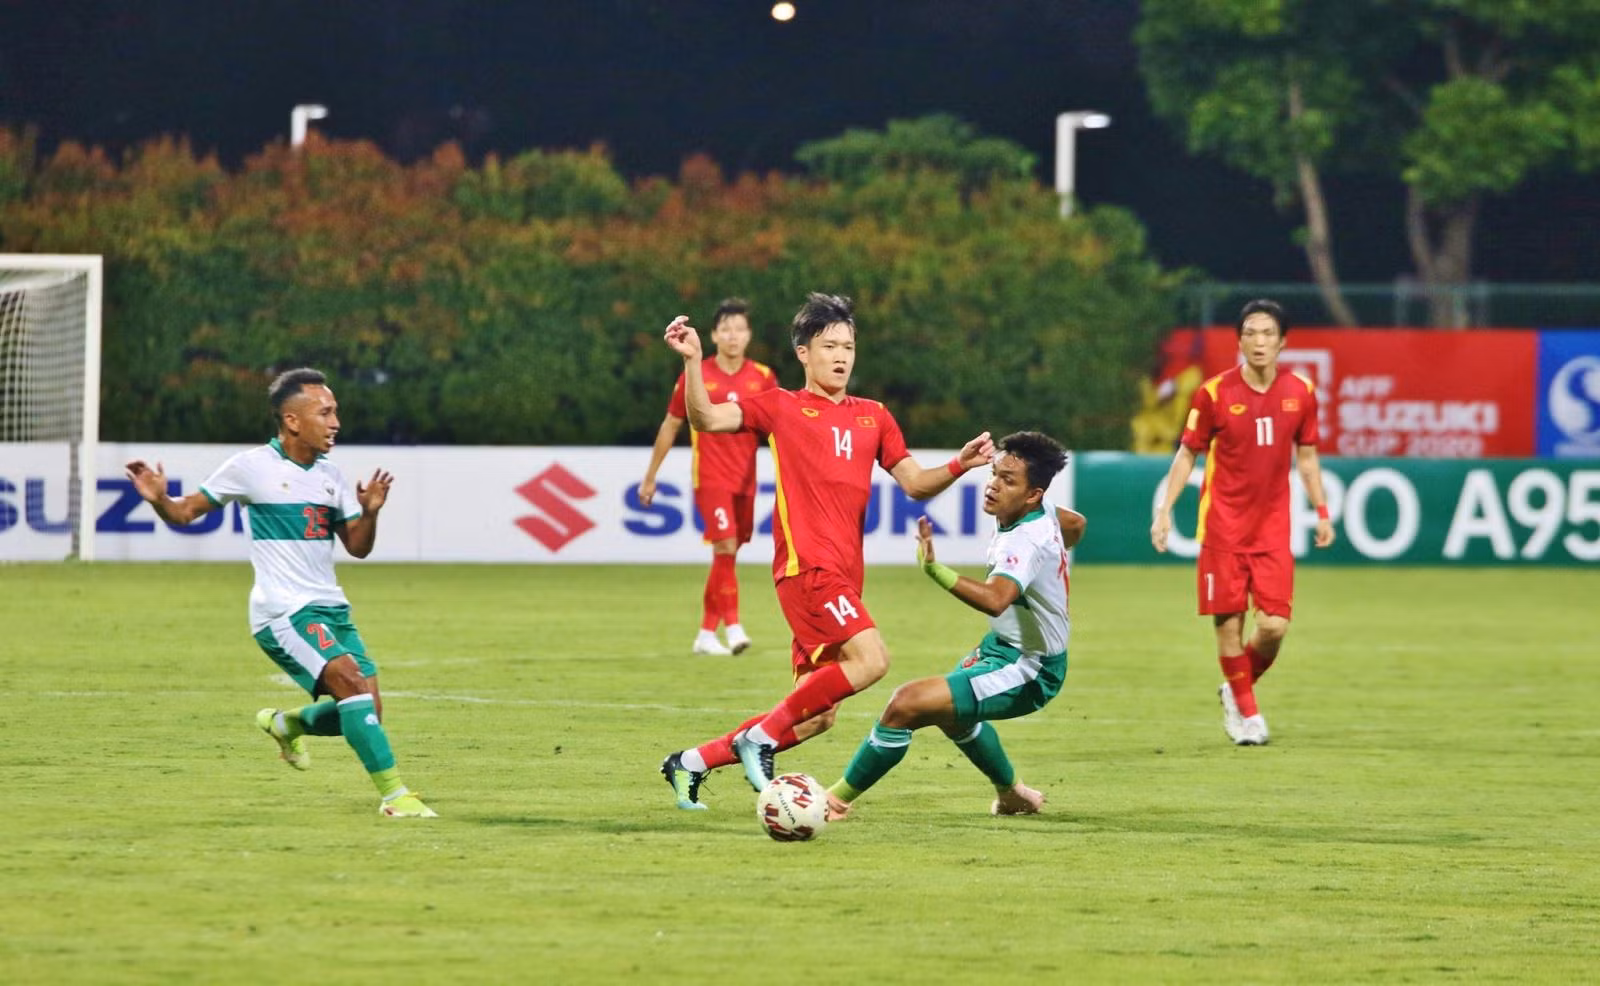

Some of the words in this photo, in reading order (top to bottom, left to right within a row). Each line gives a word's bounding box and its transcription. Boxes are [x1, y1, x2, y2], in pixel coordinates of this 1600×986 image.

[1255, 416, 1274, 446] 11
[1338, 402, 1499, 434] SUZUKI
[831, 426, 852, 461] 14
[1337, 433, 1399, 456] CUP
[304, 506, 329, 539] 25
[623, 482, 978, 537] SKI
[714, 506, 729, 531] 3
[1441, 467, 1600, 560] A95
[824, 594, 859, 627] 14
